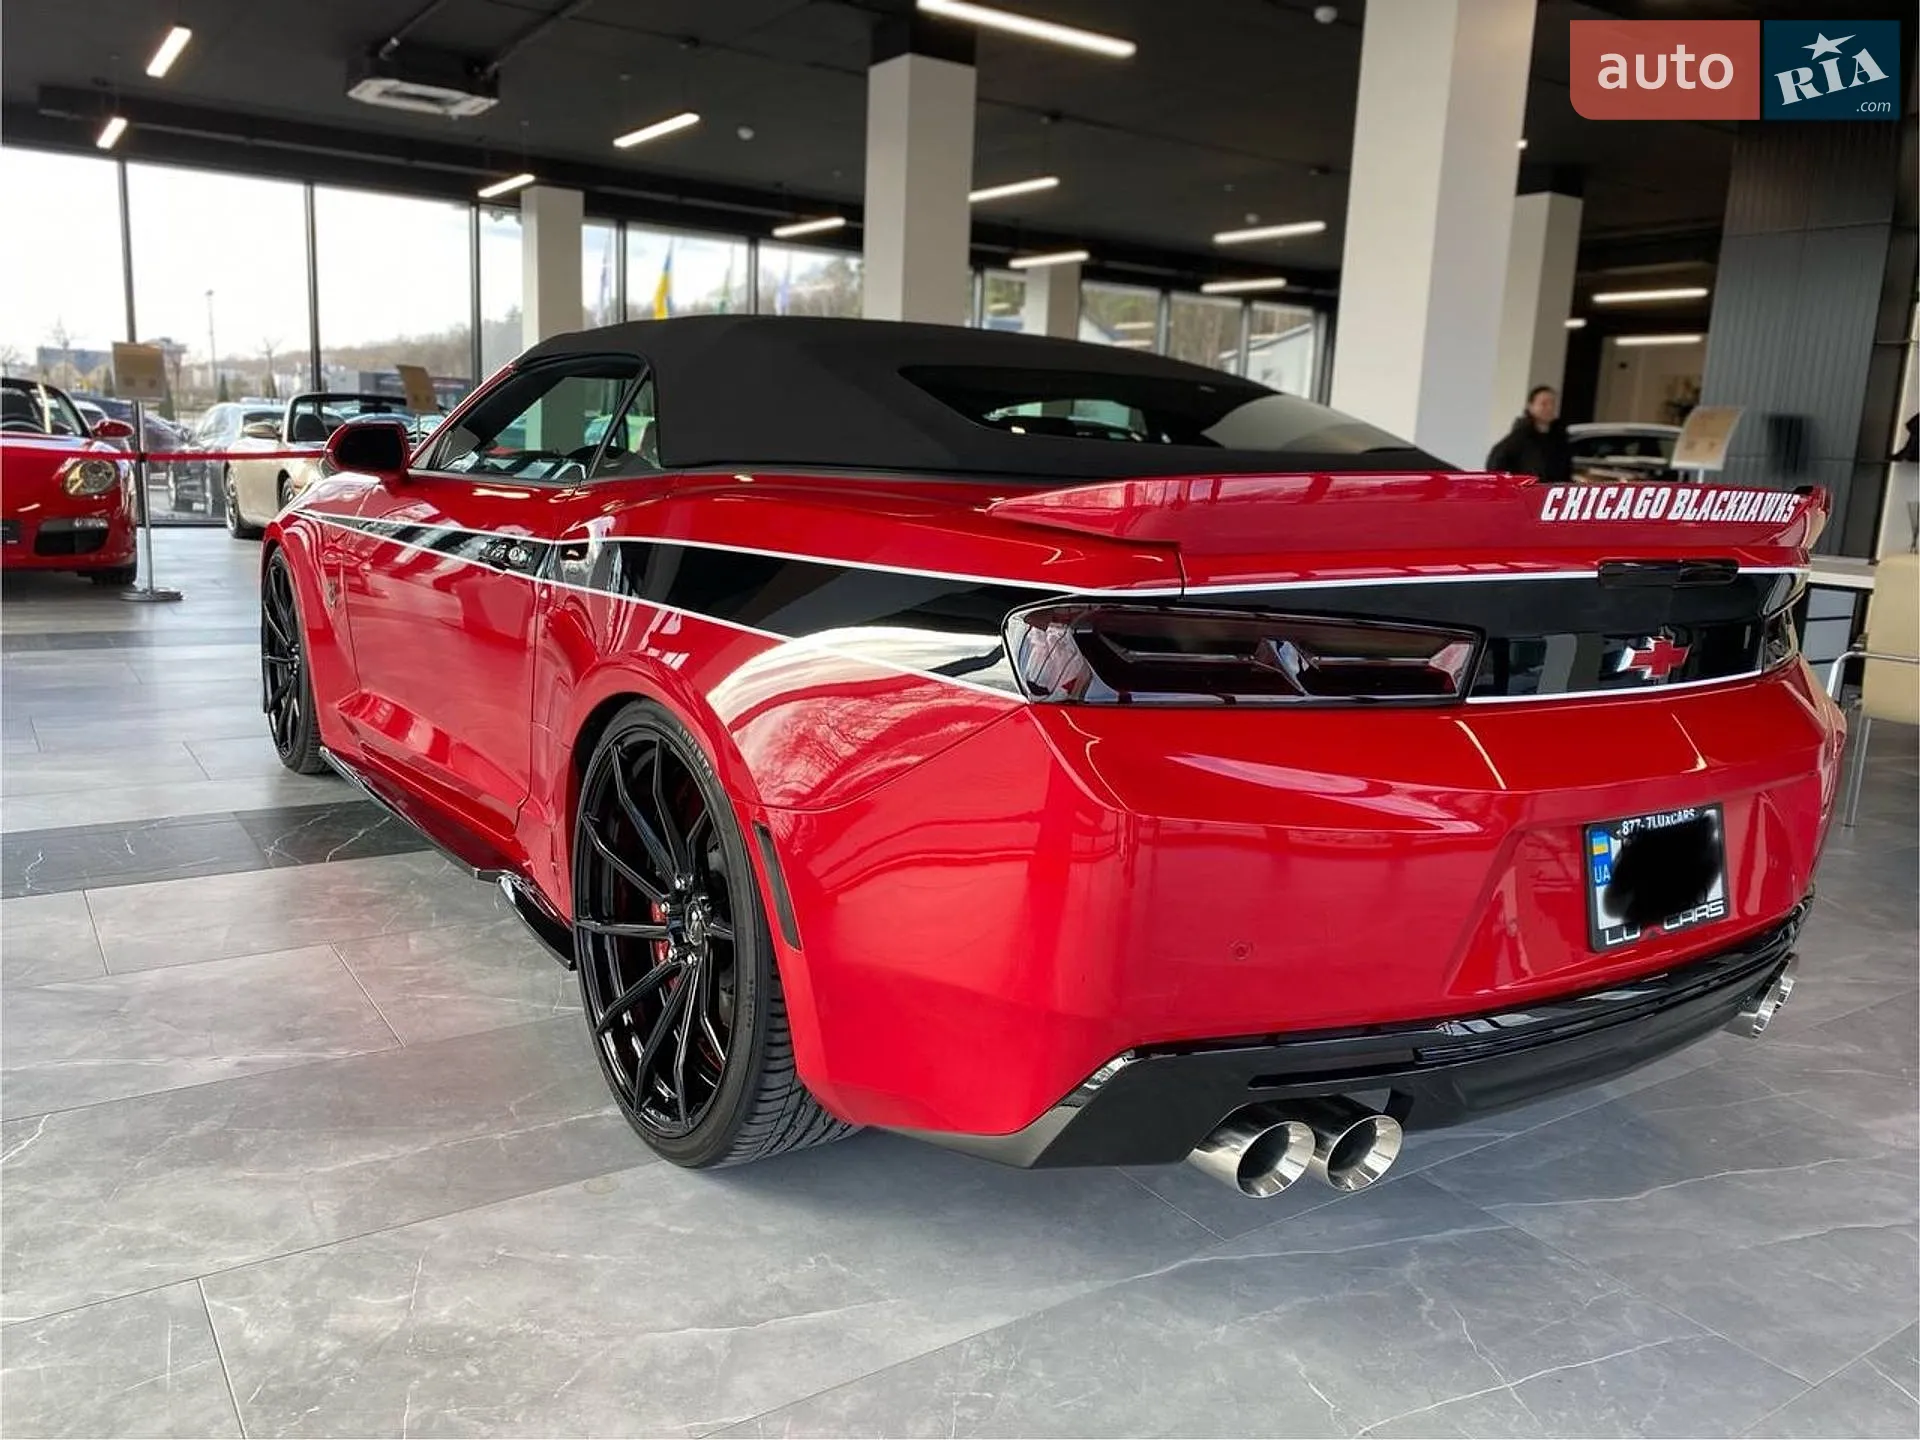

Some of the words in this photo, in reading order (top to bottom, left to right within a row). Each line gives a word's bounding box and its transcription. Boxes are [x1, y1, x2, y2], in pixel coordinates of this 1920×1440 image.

[1541, 487, 1672, 521] CHICAGO
[1667, 489, 1800, 523] BLACKHAWKS
[1594, 863, 1611, 883] UA
[1663, 900, 1724, 930] CARS
